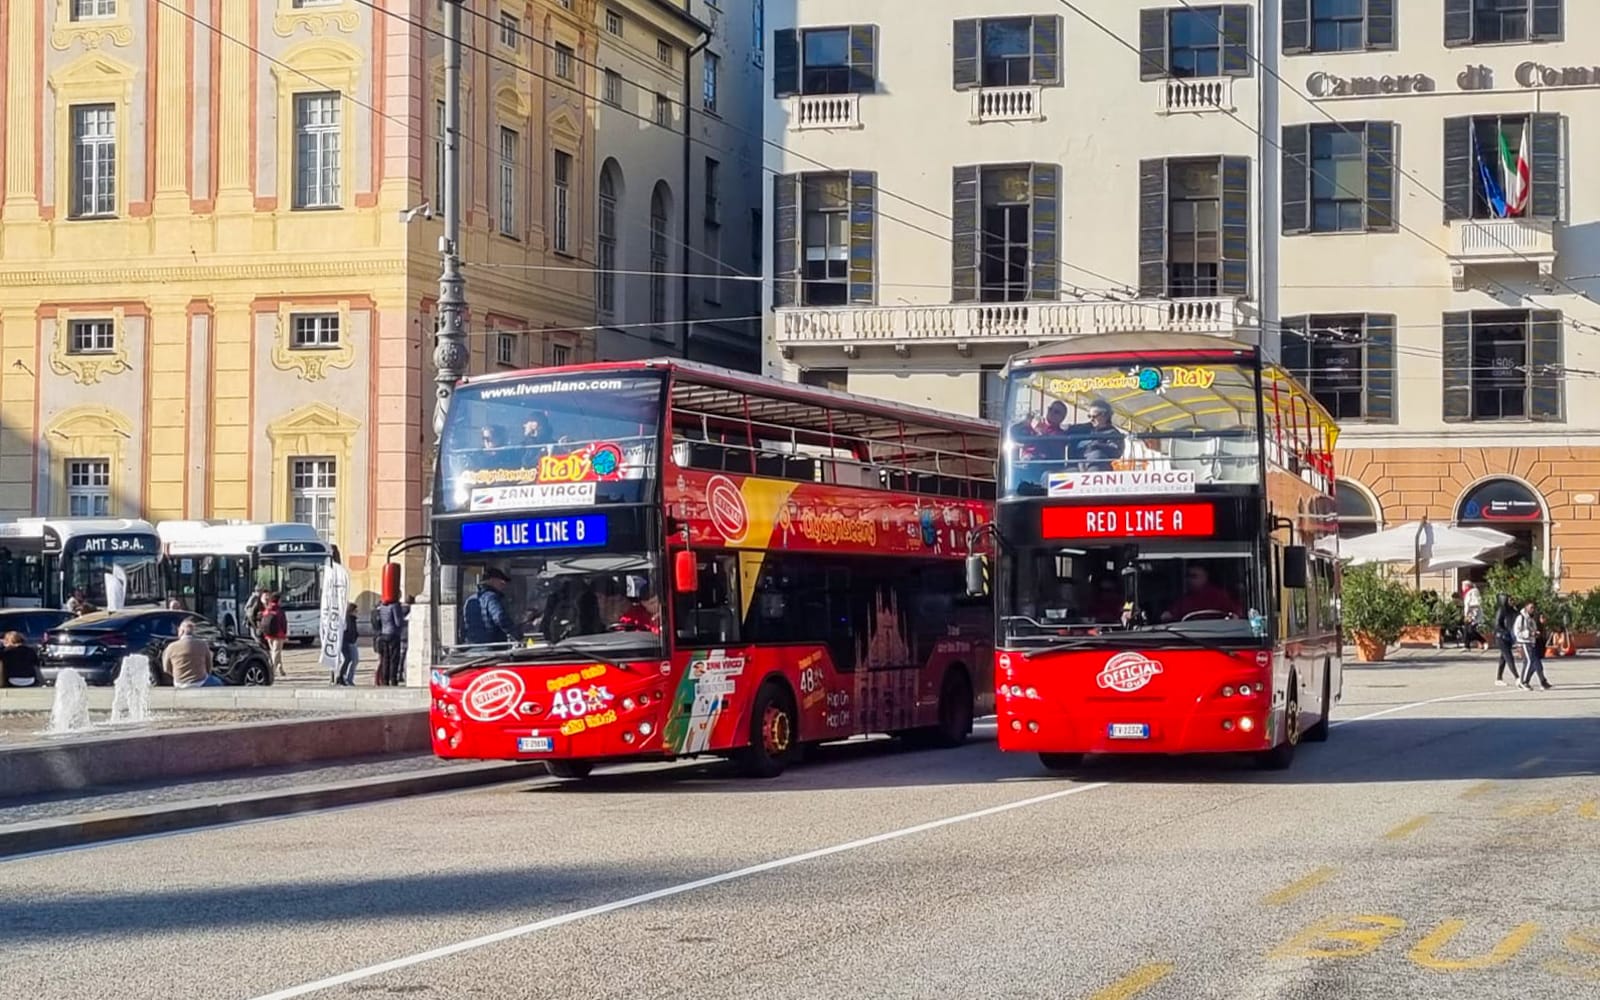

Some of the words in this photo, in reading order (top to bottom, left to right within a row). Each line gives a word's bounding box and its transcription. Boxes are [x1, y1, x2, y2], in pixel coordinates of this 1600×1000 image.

[1306, 71, 1435, 97] Camera
[1456, 63, 1493, 90] di
[1173, 367, 1216, 388] Italy
[480, 380, 622, 400] www.livemilano.com
[539, 455, 591, 481] Italy
[1081, 474, 1124, 486] ZANI
[1131, 472, 1194, 485] VIAGGI
[499, 488, 535, 500] ZANI
[540, 484, 593, 497] VIAGGI
[1086, 511, 1117, 532] RED
[1125, 510, 1164, 531] LINE
[1172, 510, 1183, 531] A
[494, 523, 529, 545] BLUE
[536, 521, 569, 543] LINE
[576, 520, 585, 541] B
[85, 538, 107, 551] AMT
[800, 668, 814, 692] 48
[1104, 663, 1160, 686] OFFICIAL
[552, 688, 586, 719] 48
